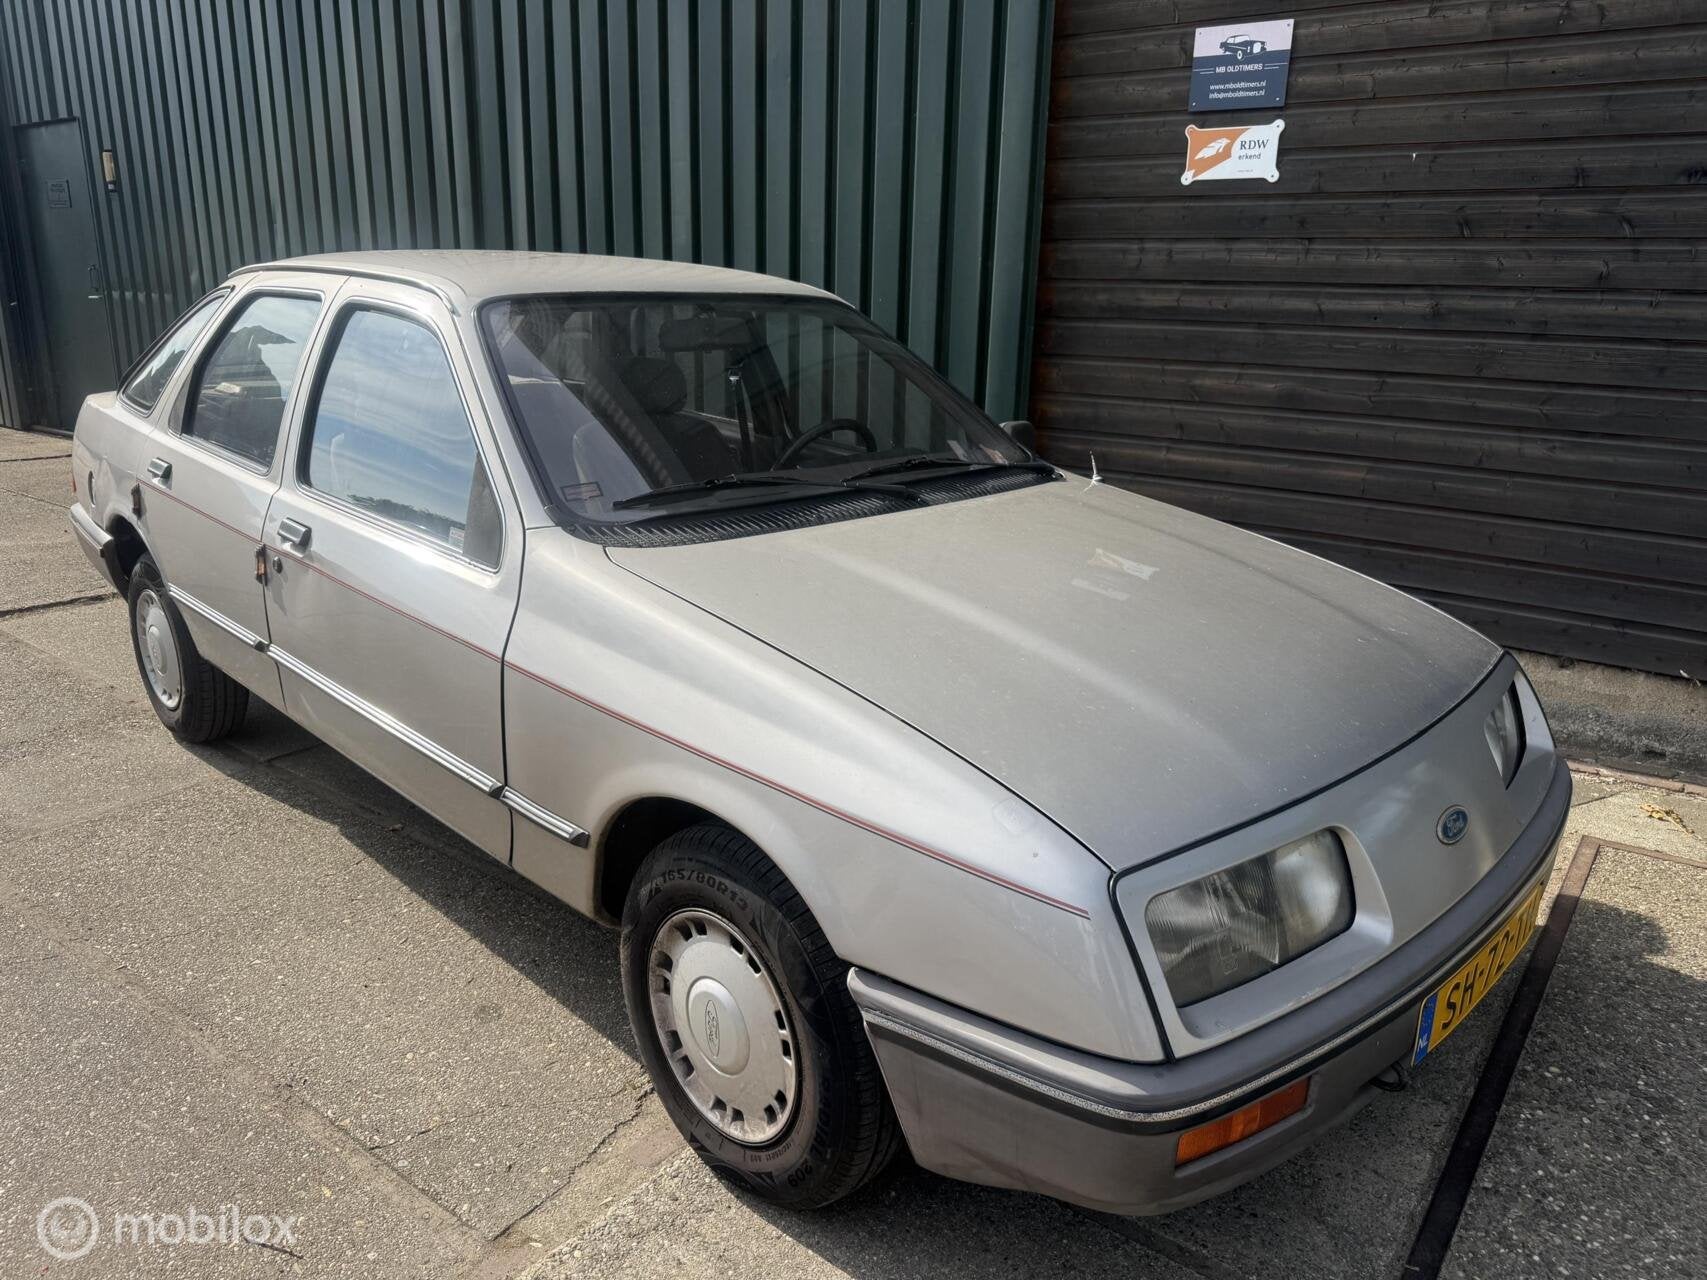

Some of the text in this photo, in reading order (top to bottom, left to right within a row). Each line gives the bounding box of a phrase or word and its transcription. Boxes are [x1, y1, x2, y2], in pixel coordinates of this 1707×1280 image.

[1215, 63, 1263, 74] MB OLDTIMERS
[1209, 80, 1267, 90] www.mboldtimers.nl
[1208, 89, 1265, 99] info@mboldtimers.nl
[1239, 139, 1269, 150] RDW
[1238, 152, 1261, 160] erkend
[1417, 1033, 1429, 1051] NL
